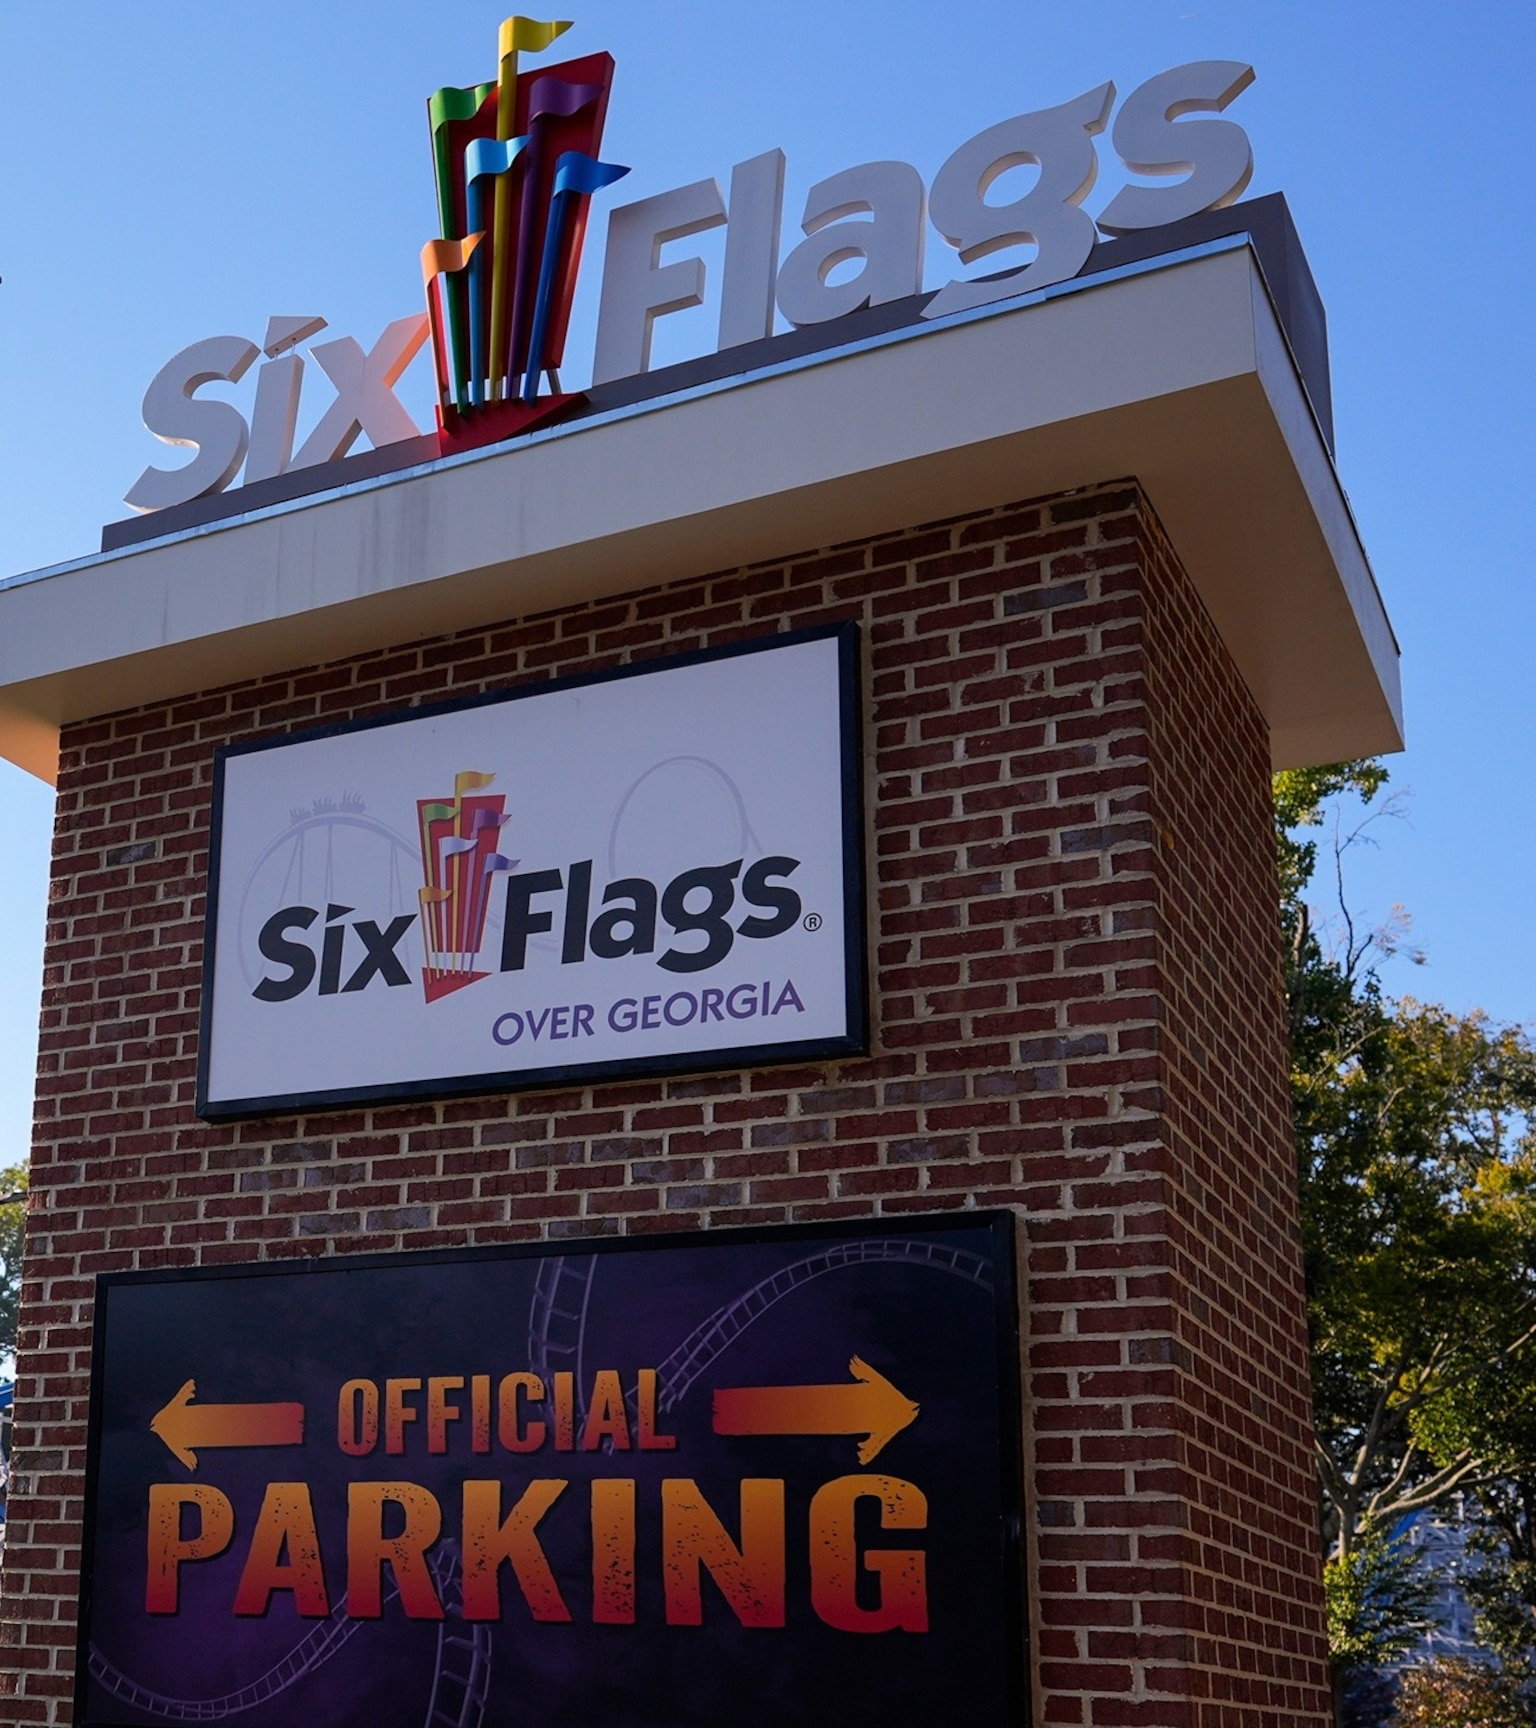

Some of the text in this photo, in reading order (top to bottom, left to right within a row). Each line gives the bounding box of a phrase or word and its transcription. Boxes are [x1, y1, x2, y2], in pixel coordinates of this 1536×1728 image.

[123, 60, 1255, 512] Six Flags
[251, 902, 418, 1003] Six
[491, 978, 805, 1046] OVER GEORGIA
[336, 1368, 677, 1457] OFFICIAL
[144, 1473, 931, 1634] PARKING
